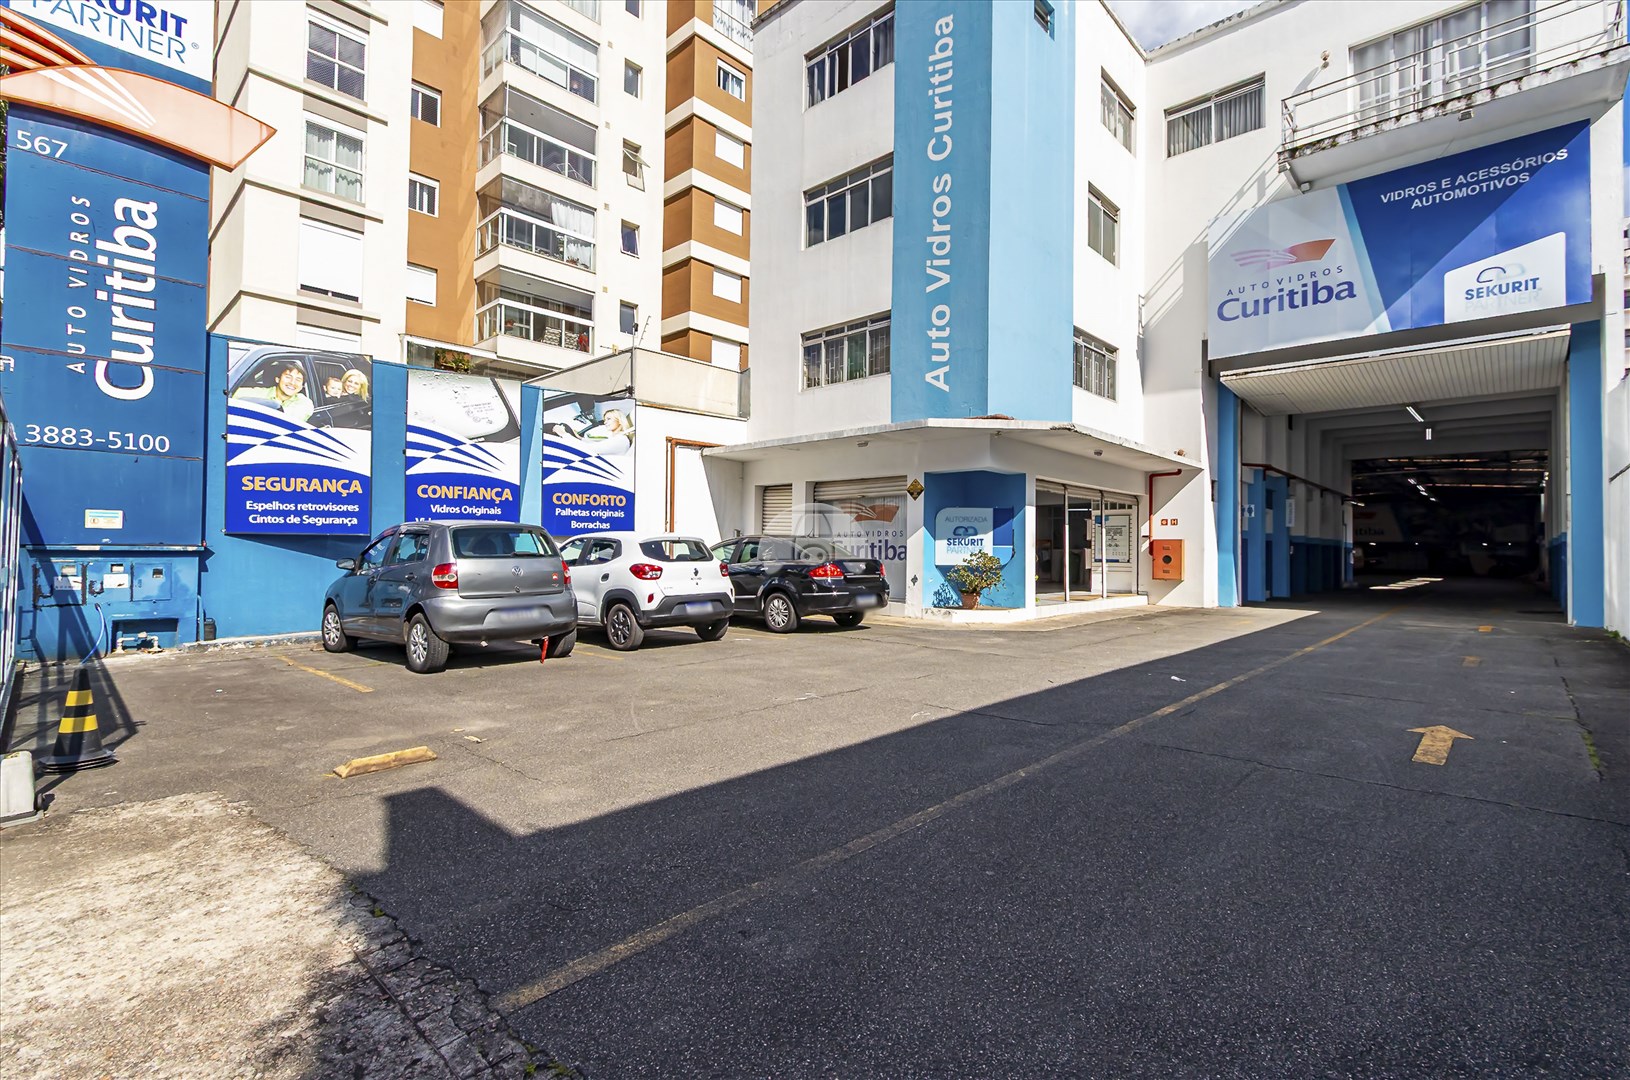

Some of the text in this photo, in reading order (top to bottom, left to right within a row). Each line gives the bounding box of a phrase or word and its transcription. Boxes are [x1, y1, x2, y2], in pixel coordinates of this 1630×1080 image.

[16, 130, 68, 159] 567
[1380, 148, 1569, 203] VIDROS E ACESSÓRIOS
[1411, 172, 1530, 210] AUTOMOTIVOS
[925, 14, 954, 392] Auto Vidros Curitiba
[66, 195, 91, 374] AUTO VIDROS
[1465, 277, 1540, 301] SEKURIT
[94, 197, 158, 401] Curitiba
[1217, 280, 1357, 322] Curitiba
[25, 424, 170, 453] 3883-5100
[241, 476, 363, 497] SEGURANÇA
[417, 484, 513, 504] CONFIANÇA
[245, 500, 360, 512] Espelhos retrovisores
[430, 504, 502, 516] Vidros Originais
[552, 492, 627, 507] CONFORTO
[248, 514, 358, 526] Cintos de Segurança
[555, 507, 625, 519] Palhetas originais
[945, 515, 987, 523] AUTORIZADA
[571, 521, 610, 529] Borrachas
[946, 538, 984, 546] SEKURIT
